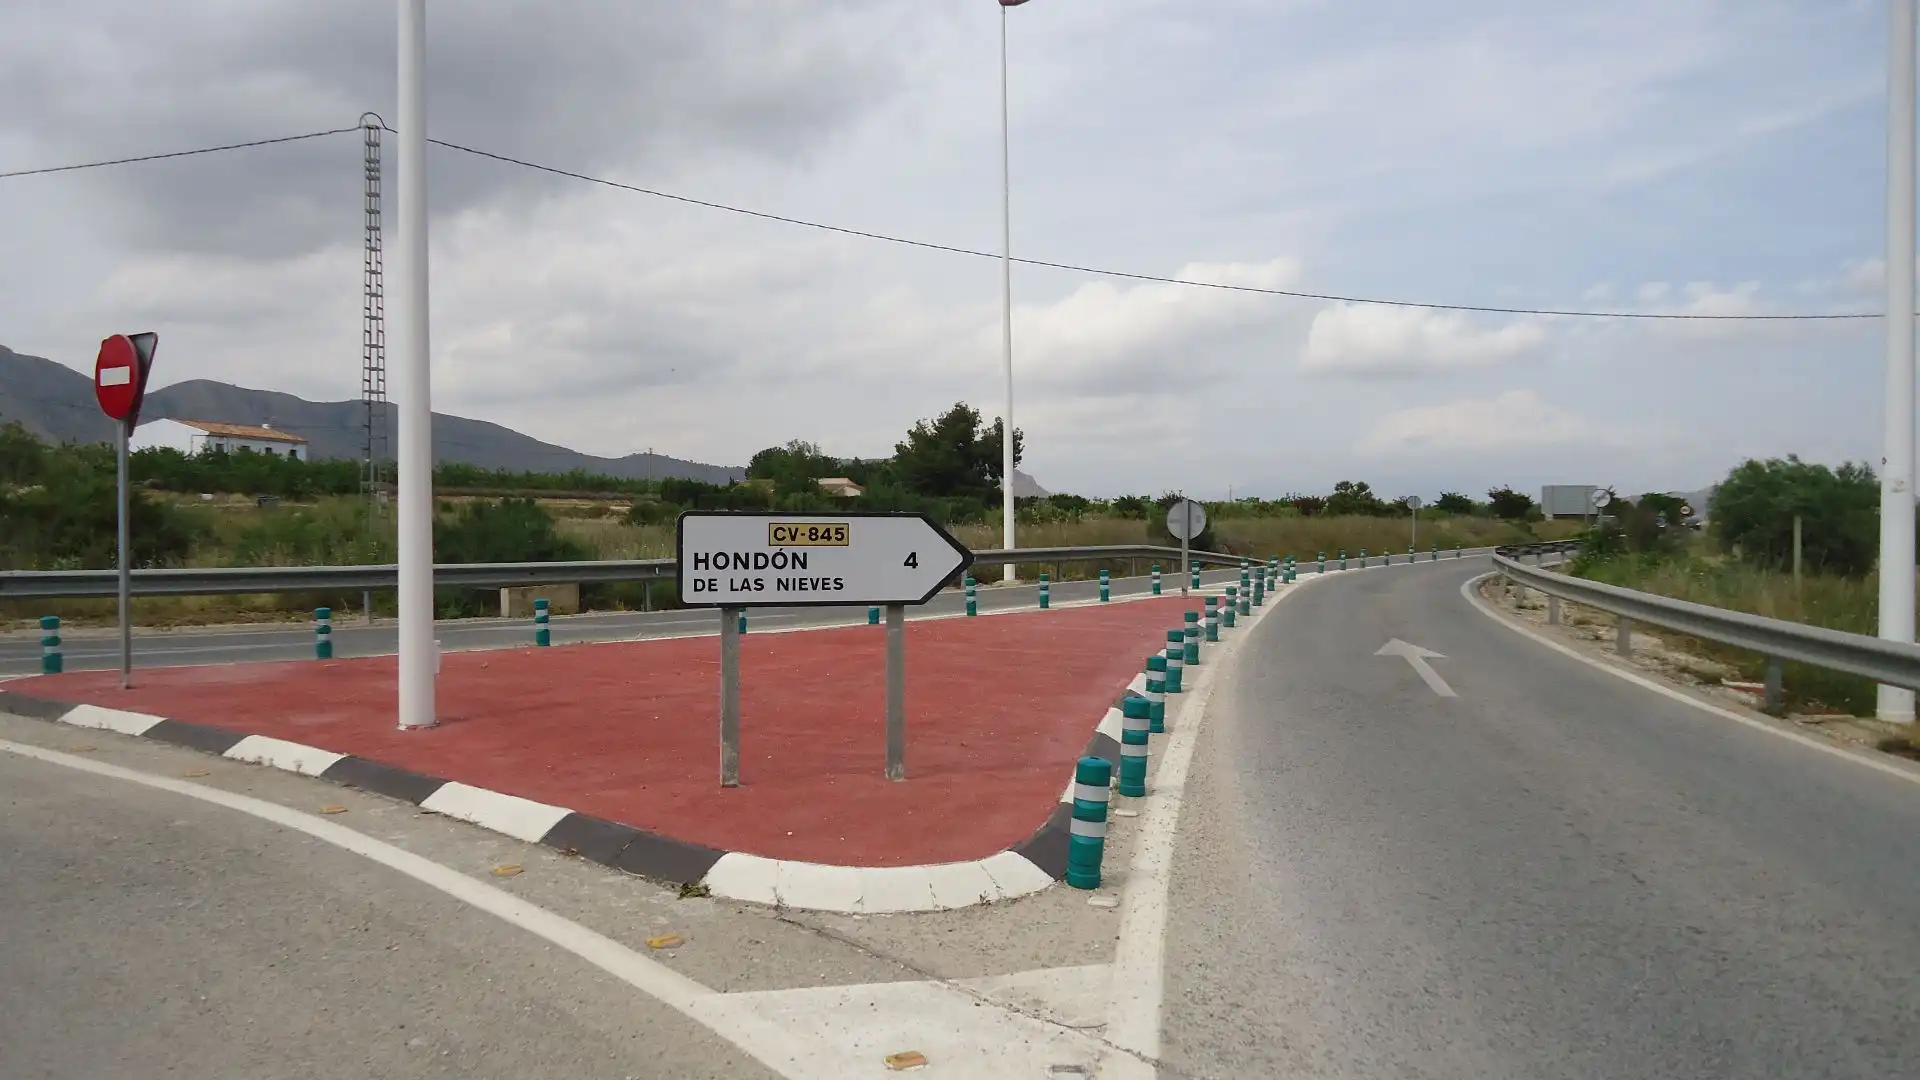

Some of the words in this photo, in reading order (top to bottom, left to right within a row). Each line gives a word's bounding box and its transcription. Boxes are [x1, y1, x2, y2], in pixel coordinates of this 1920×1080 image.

[773, 526, 846, 543] CV-845
[693, 548, 809, 571] HONDÓN
[903, 551, 919, 570] 4
[693, 578, 719, 592] DE
[729, 577, 765, 592] LAS
[776, 576, 845, 592] NIEVES
